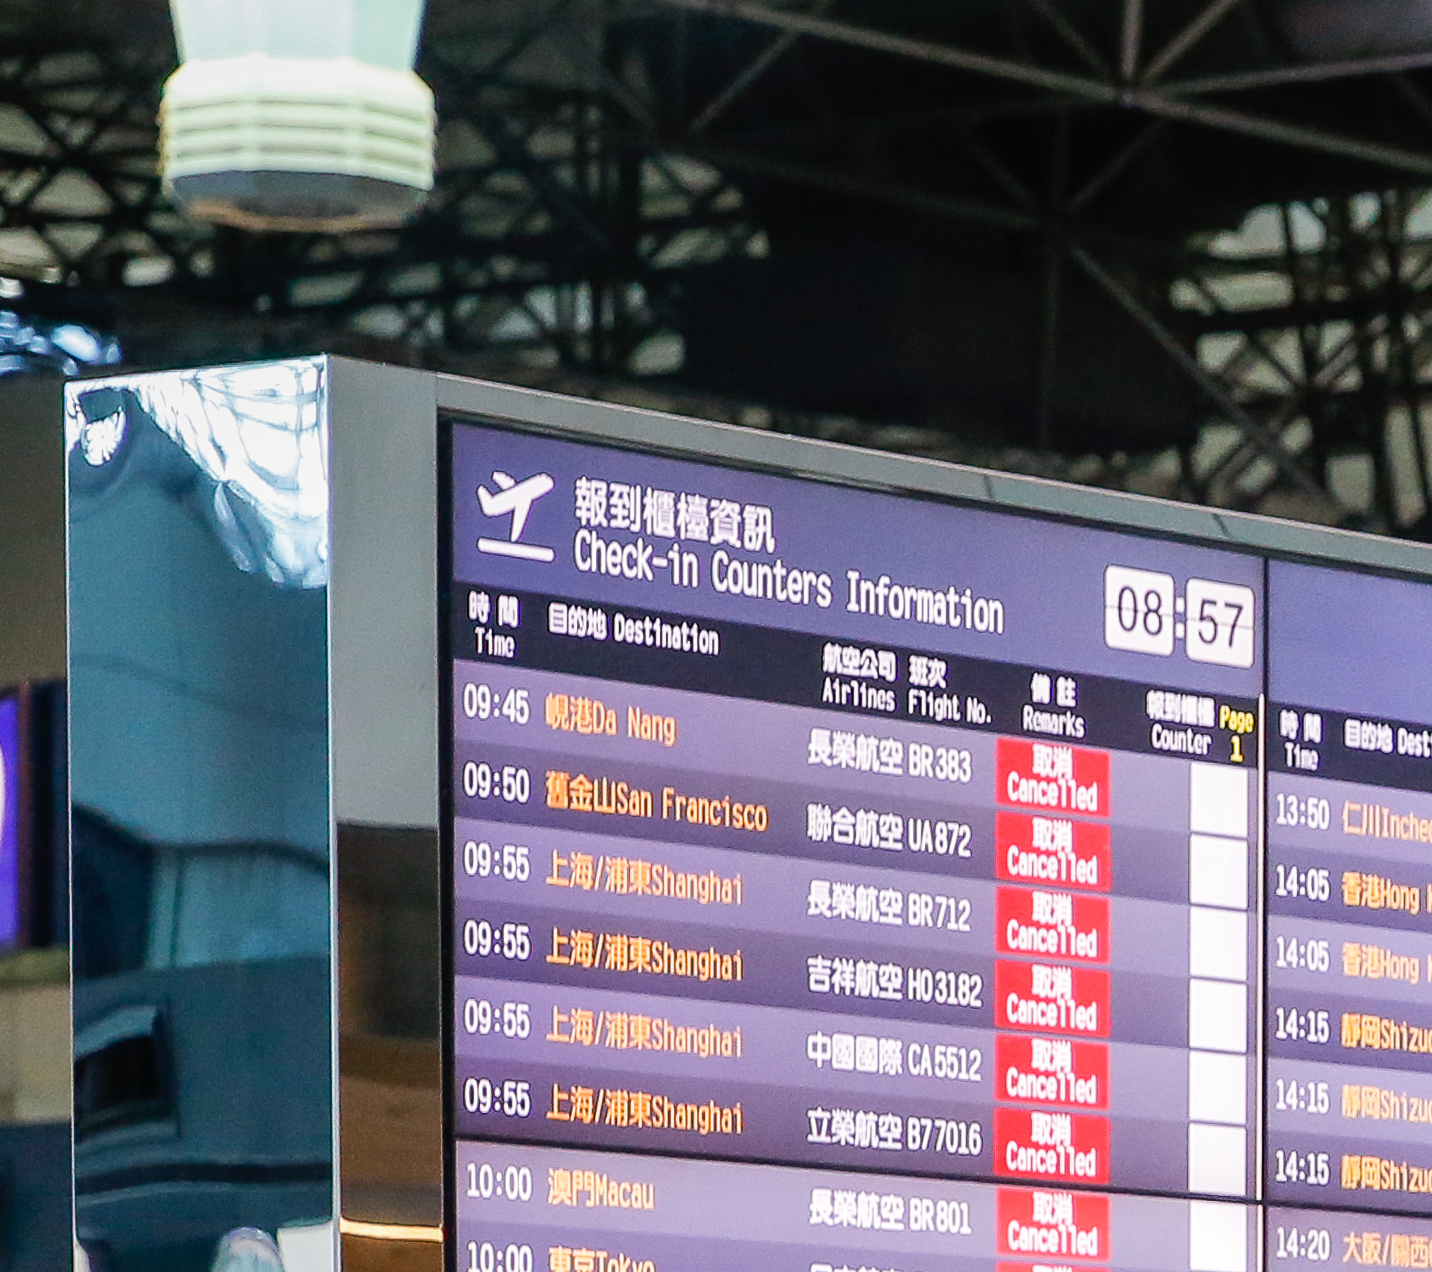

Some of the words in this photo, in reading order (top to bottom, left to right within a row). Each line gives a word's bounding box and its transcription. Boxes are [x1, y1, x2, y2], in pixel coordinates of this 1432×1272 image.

[574, 476, 775, 553] 報到櫃檯資訊
[574, 529, 699, 587] Check-in
[711, 553, 833, 608] Counters
[846, 569, 1004, 634] Information
[476, 630, 515, 658] Time
[822, 677, 895, 713] Airlines
[908, 689, 959, 722] Flight
[967, 698, 992, 726] No.
[1023, 705, 1084, 739] Remarks
[1151, 727, 1212, 757] Counter
[1229, 735, 1243, 762] 1
[548, 604, 607, 640] 目的地
[614, 614, 719, 656] Destination
[823, 645, 897, 683] 航空公司
[908, 658, 946, 689] 班次
[1219, 705, 1254, 735] Page
[464, 683, 529, 724] 09:45
[628, 705, 677, 747] Nang
[808, 727, 902, 774] 長榮航空
[1284, 744, 1317, 771] Time
[1032, 742, 1072, 778] 取消
[464, 761, 529, 803] 09:50
[662, 786, 769, 832] Francisco
[807, 803, 902, 850] 聯合航空
[1007, 769, 1098, 812] Cancelled
[1276, 793, 1329, 830] 13:50
[1032, 815, 1072, 850] 取消
[1007, 842, 1098, 884] Cancelled
